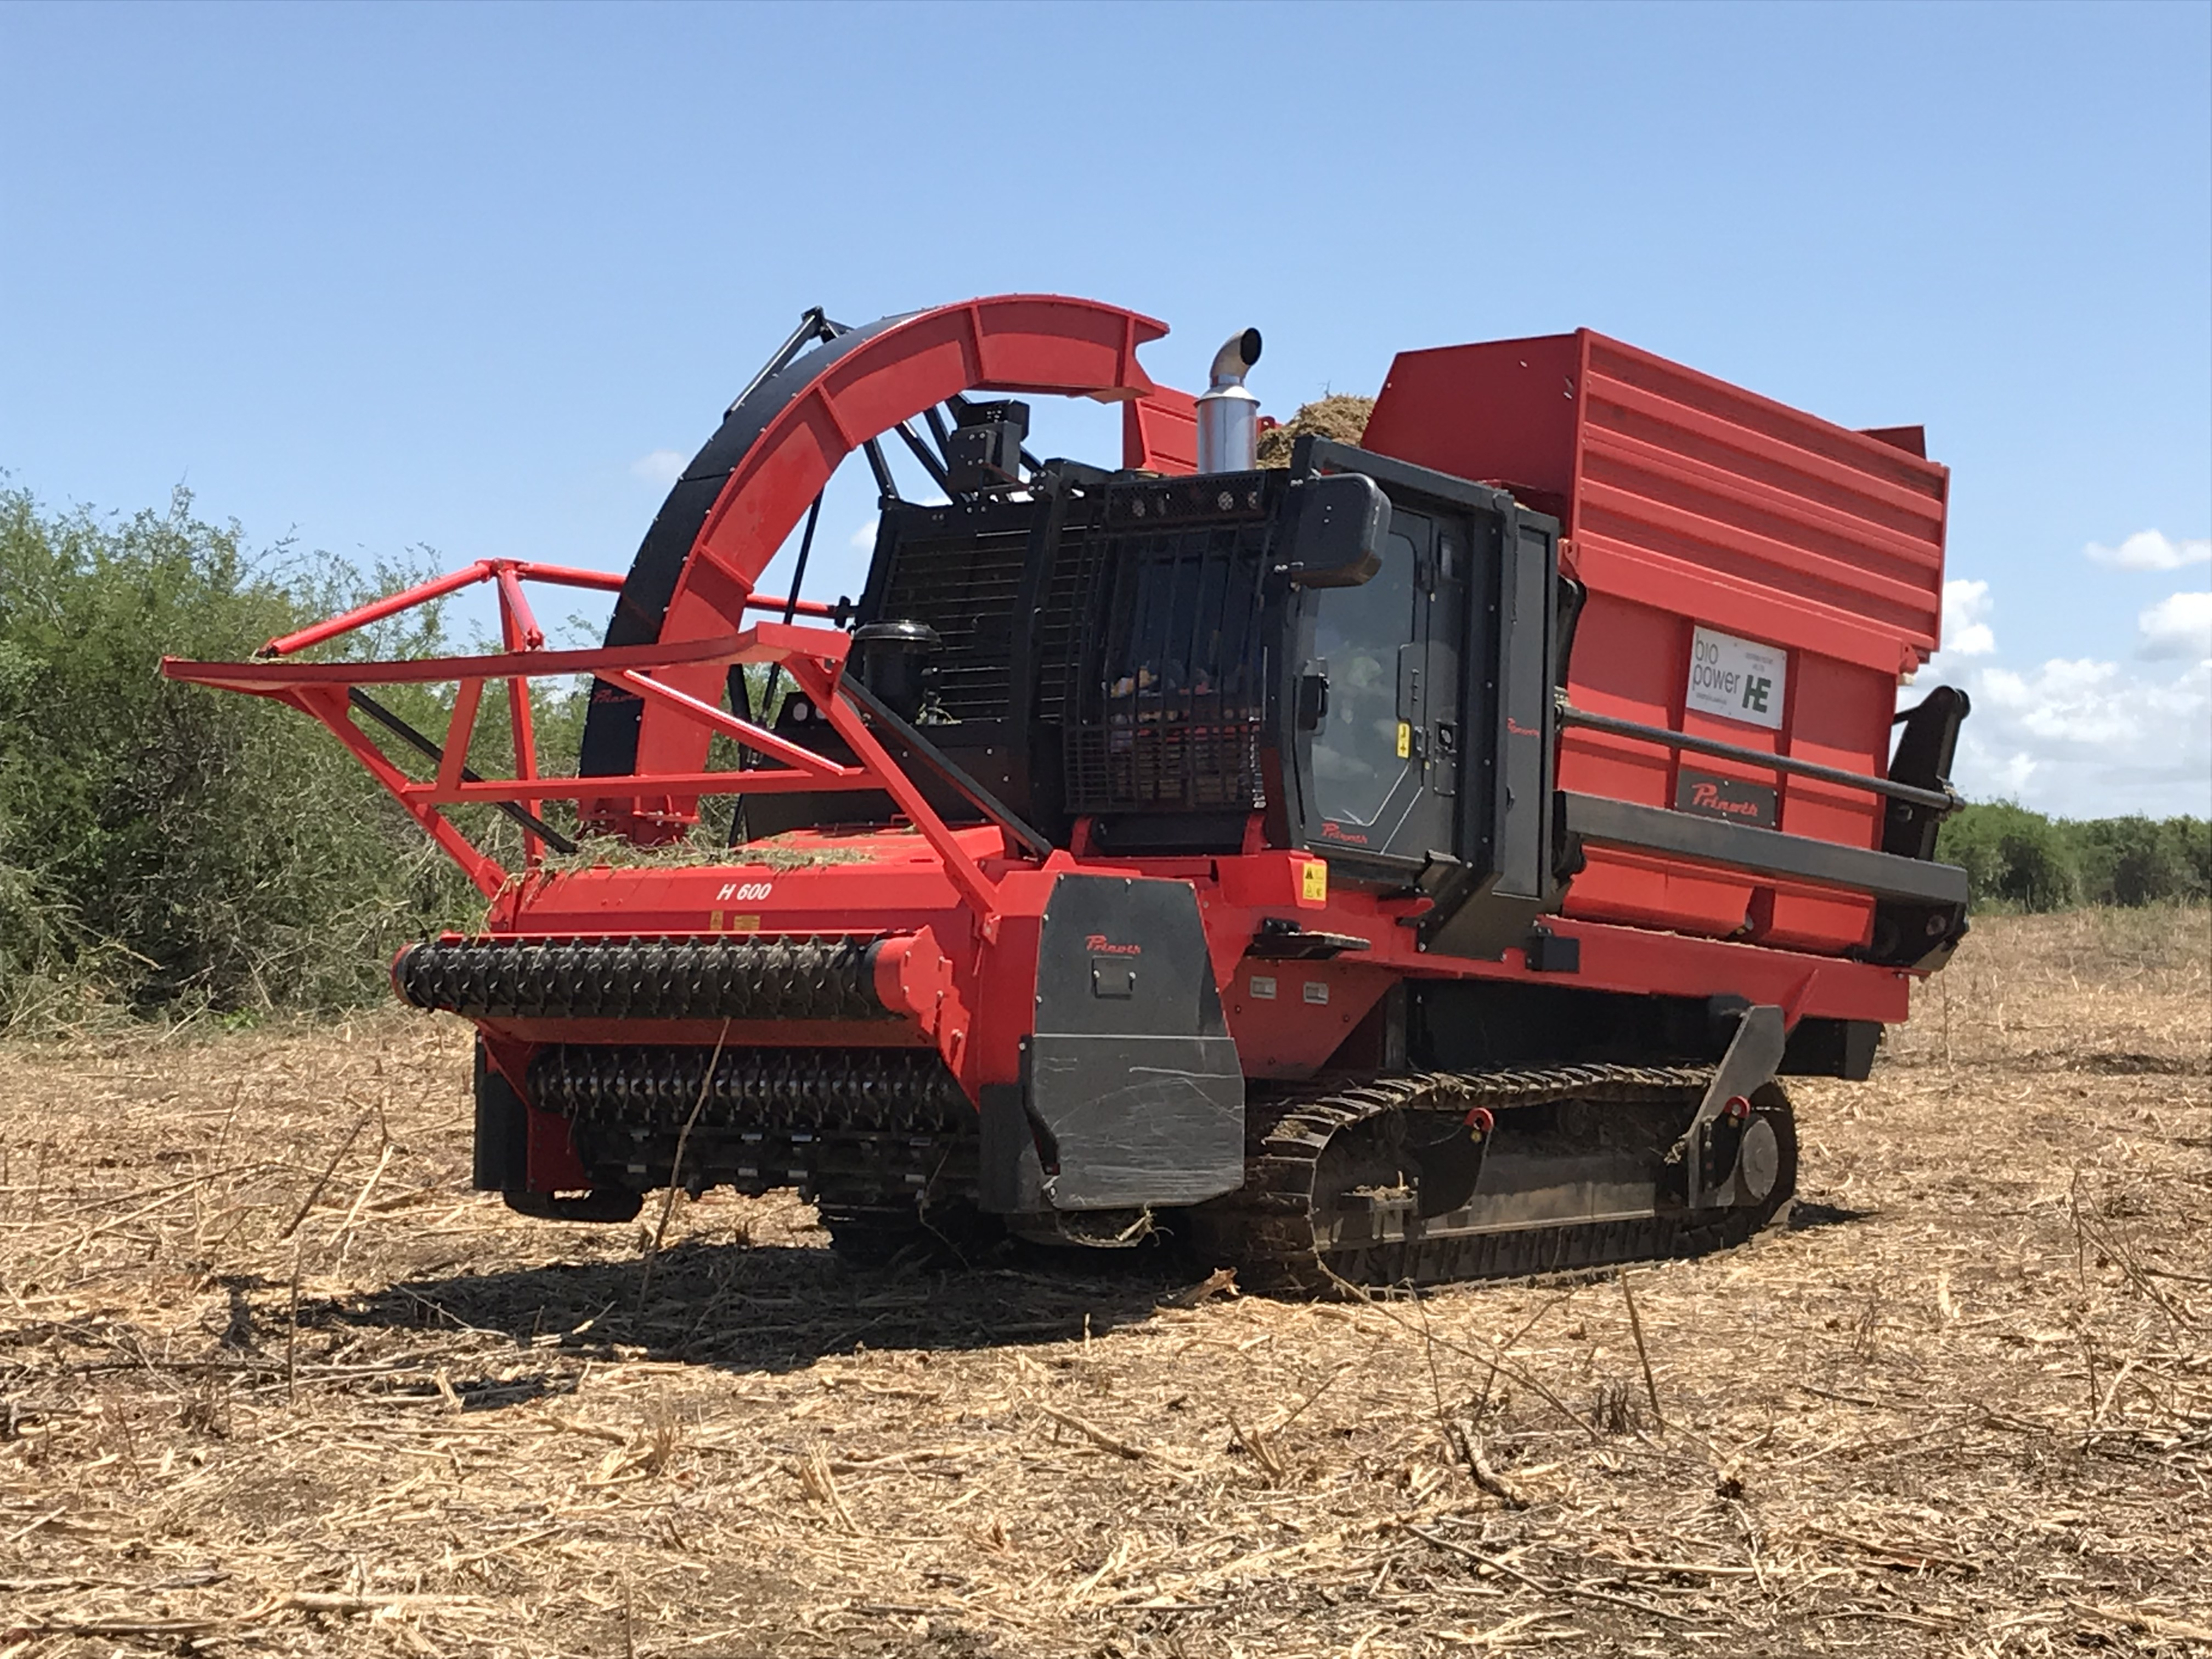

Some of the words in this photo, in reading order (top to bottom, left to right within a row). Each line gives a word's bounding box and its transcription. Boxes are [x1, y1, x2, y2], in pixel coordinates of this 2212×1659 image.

[1695, 633, 1719, 665] bio
[1692, 664, 1741, 695] power
[1742, 674, 1772, 714] HE
[1691, 782, 1758, 817] Prinoth
[715, 883, 737, 901] H
[736, 882, 773, 901] 600
